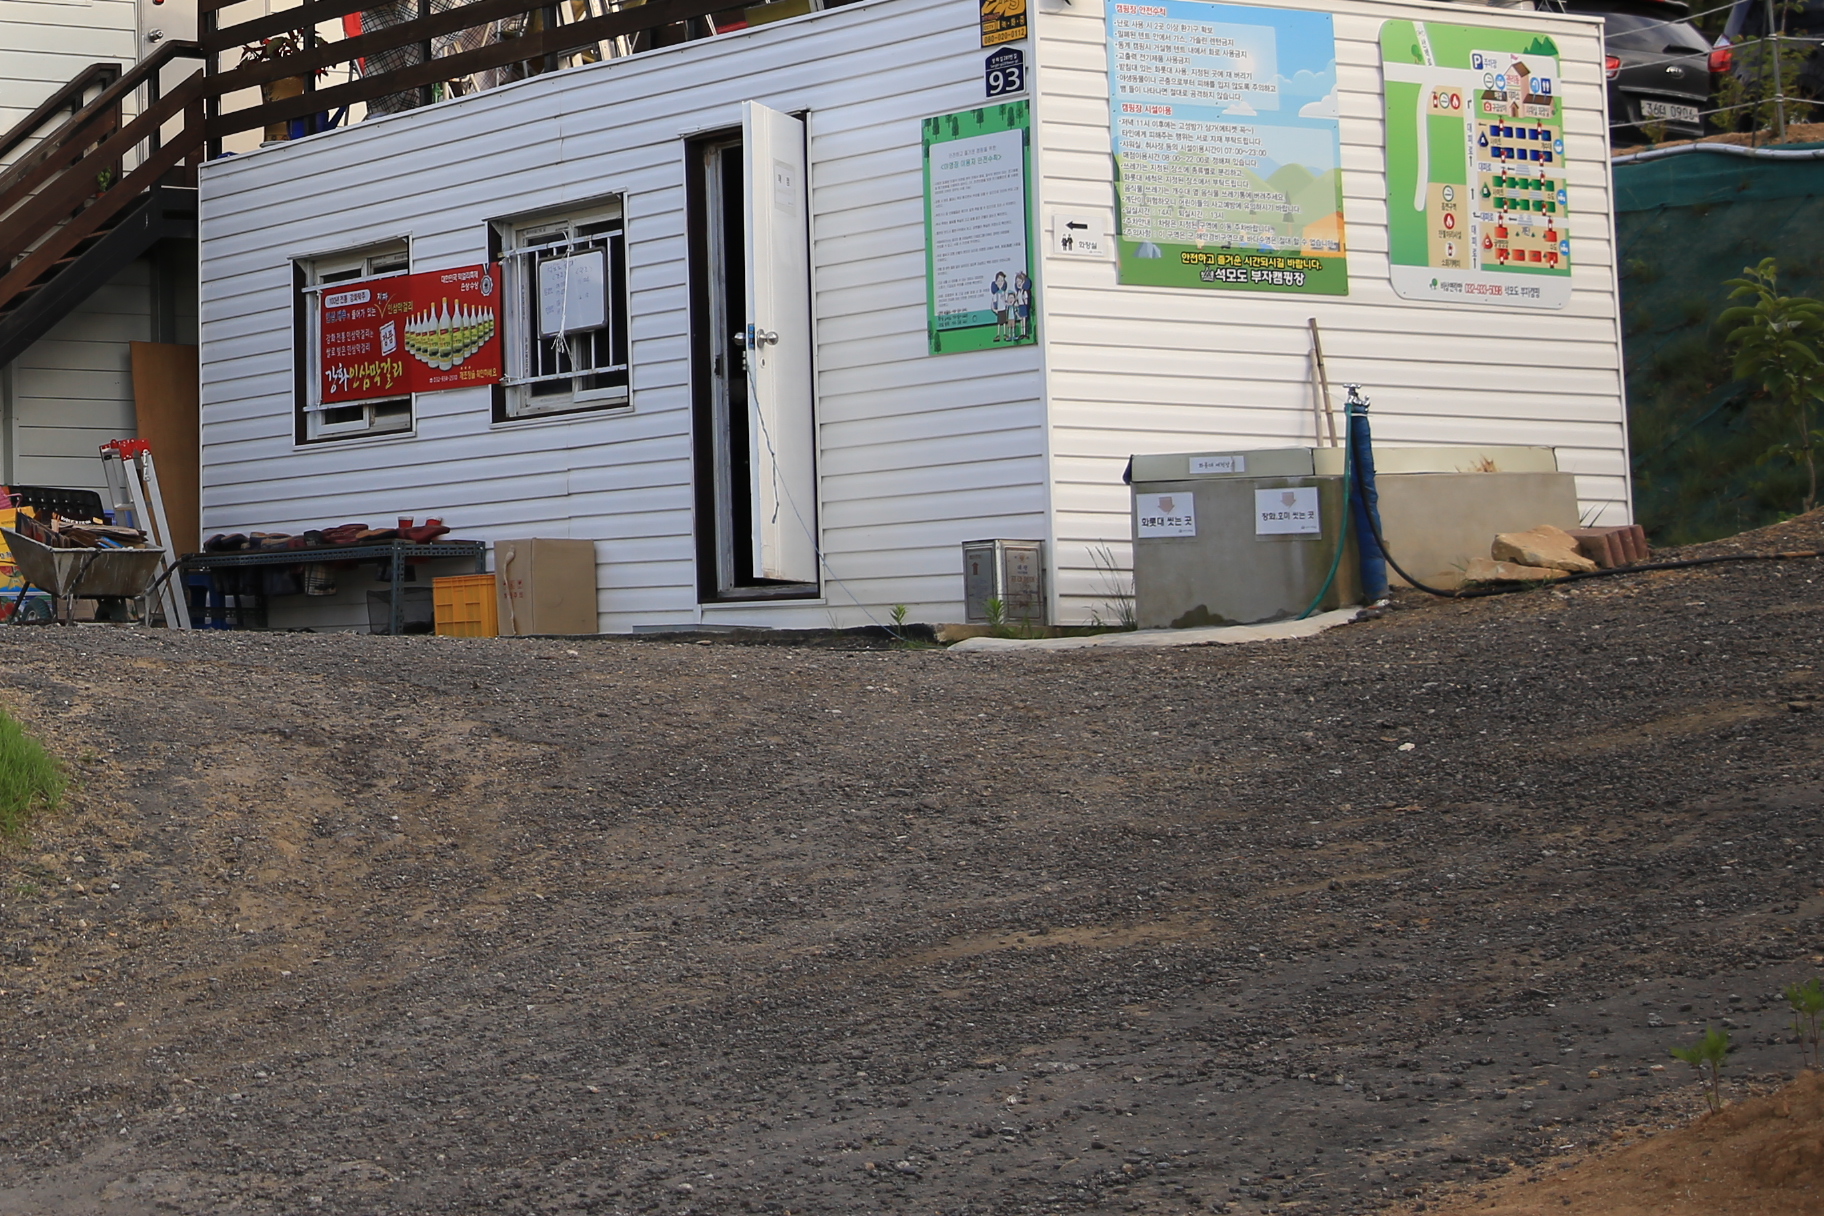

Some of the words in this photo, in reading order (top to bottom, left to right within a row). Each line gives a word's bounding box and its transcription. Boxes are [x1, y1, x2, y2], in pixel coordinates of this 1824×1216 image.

[1116, 5, 1137, 14] 캠핑장
[1139, 7, 1166, 16] 안전수칙
[1167, 24, 1179, 32] 이상
[1181, 25, 1199, 33] 환기구
[984, 28, 1024, 45] 080-020-0112
[1119, 53, 1137, 61] 고출력
[1166, 56, 1190, 64] 사용금지
[1222, 49, 1247, 58] 사용금지
[1191, 69, 1210, 77] 지정된
[1234, 72, 1252, 80] 버리기
[989, 67, 1020, 94] 93
[1143, 87, 1168, 96] 나타나면
[1170, 89, 1188, 97] 절대로
[1122, 104, 1142, 113] 캠핑장
[1145, 105, 1172, 115] 시설이용
[961, 158, 976, 167] 이용자
[1079, 241, 1097, 249] 화장실
[1181, 252, 1215, 265] 안전하고
[1217, 254, 1243, 266] 즐거운
[1244, 256, 1285, 268] 시간되시길
[1287, 258, 1322, 269] 바랍니다.
[1215, 268, 1248, 282] 석모도
[1251, 270, 1305, 286] 부자캠핑장
[387, 301, 413, 314] 인삼막걸리
[1292, 512, 1305, 520] 씻는
[1308, 511, 1314, 519] 곳
[1141, 518, 1164, 527] 화롯대
[1167, 517, 1181, 527] 씻는
[1184, 516, 1192, 526] 곳
